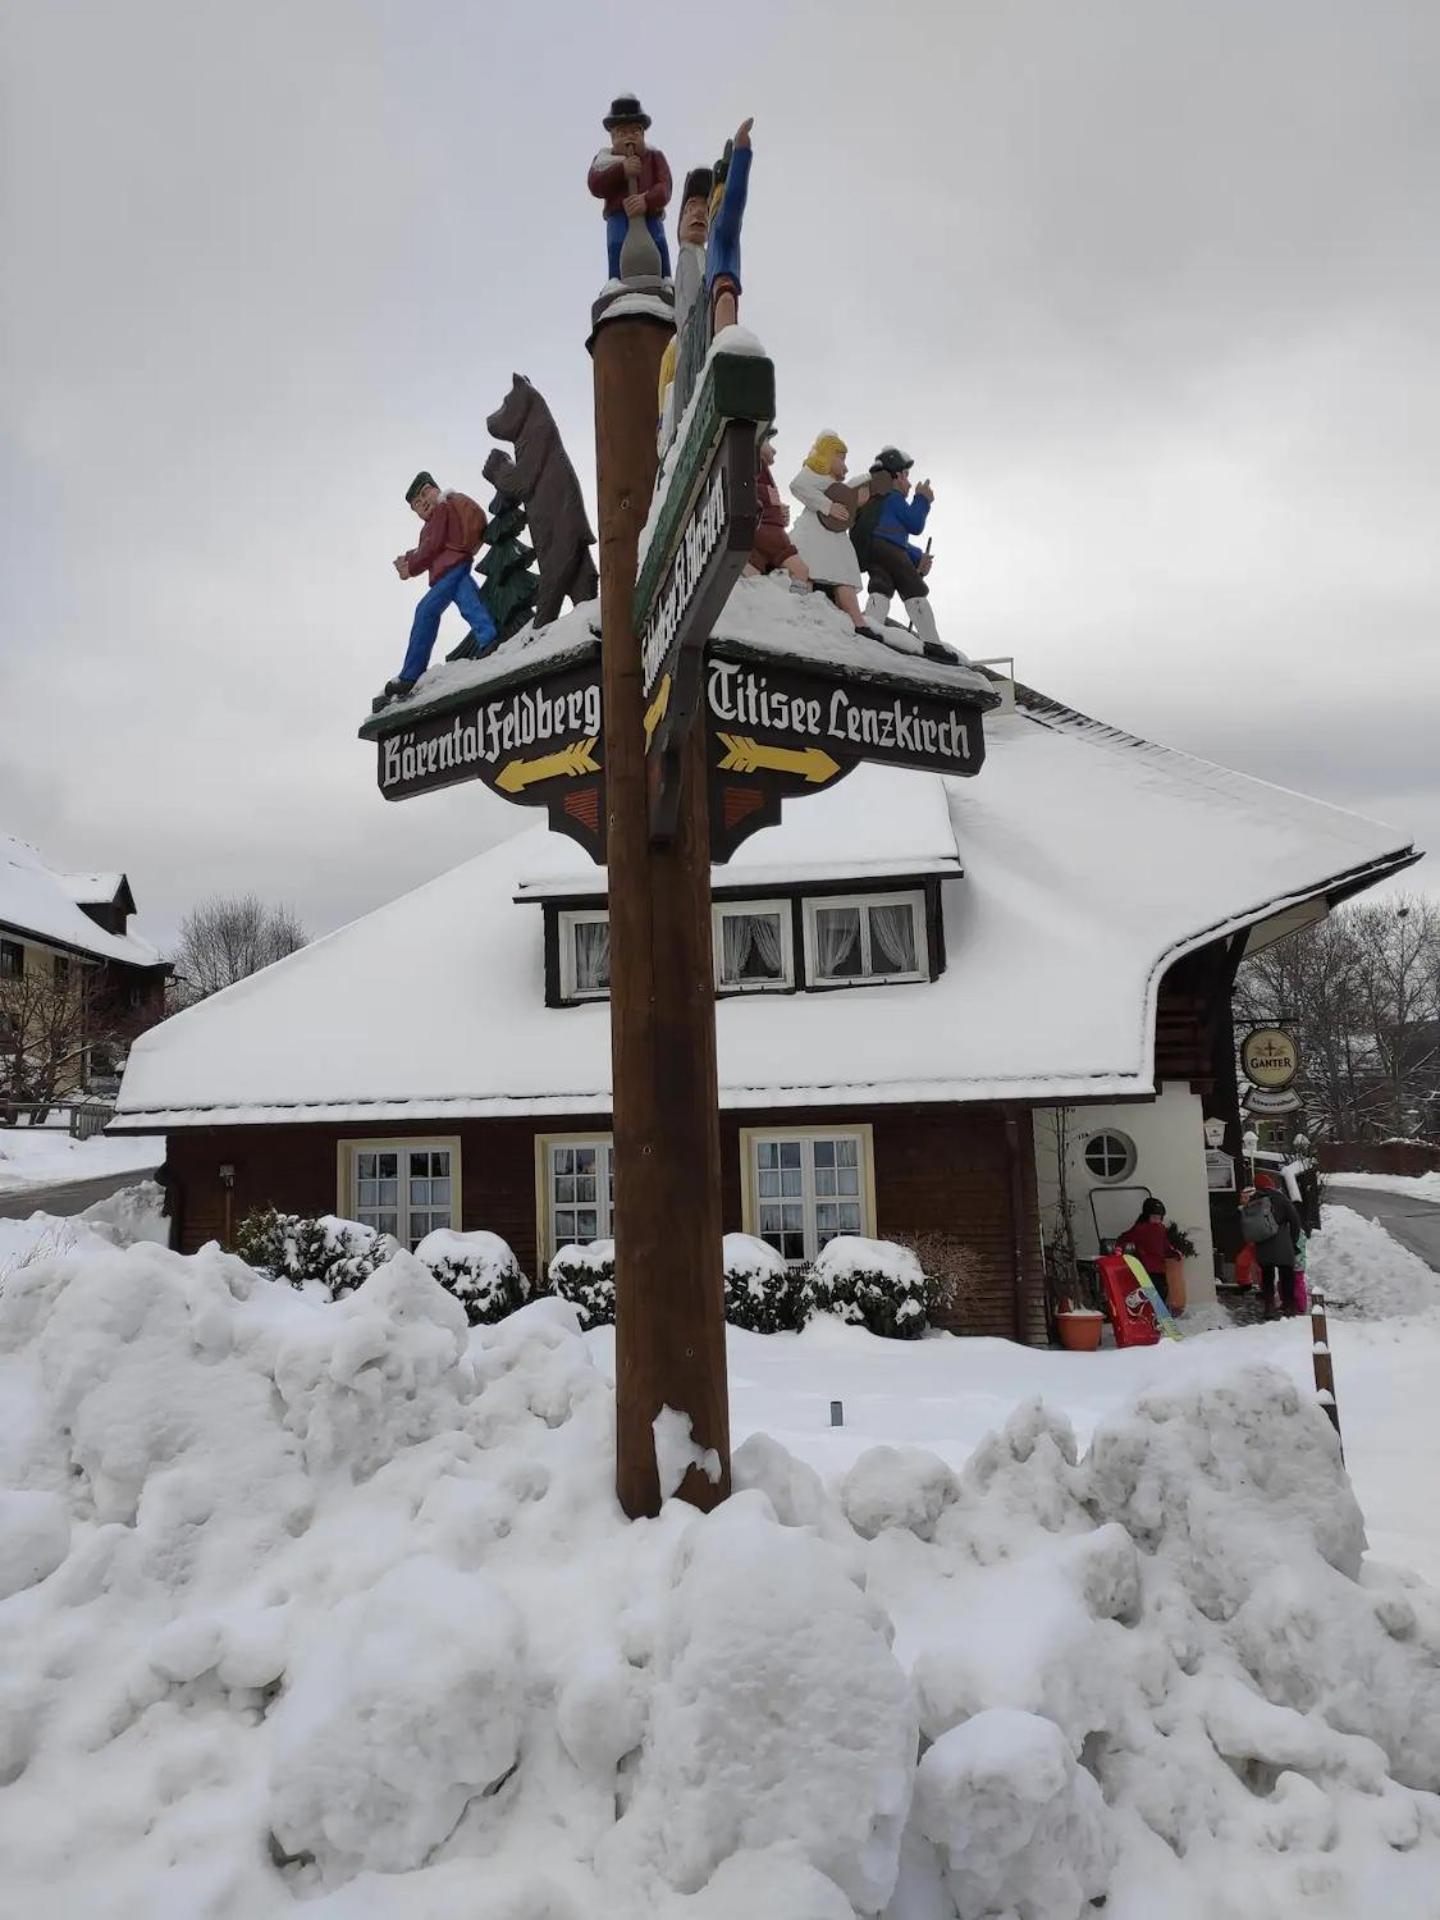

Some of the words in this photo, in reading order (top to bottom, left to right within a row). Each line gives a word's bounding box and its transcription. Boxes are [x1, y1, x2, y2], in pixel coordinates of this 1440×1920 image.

[383, 707, 486, 787] Bärental
[484, 684, 601, 764] Feldberg
[708, 658, 822, 735] Titisee
[827, 688, 971, 759] Lenzkirch
[1250, 1057, 1292, 1069] GANTER
